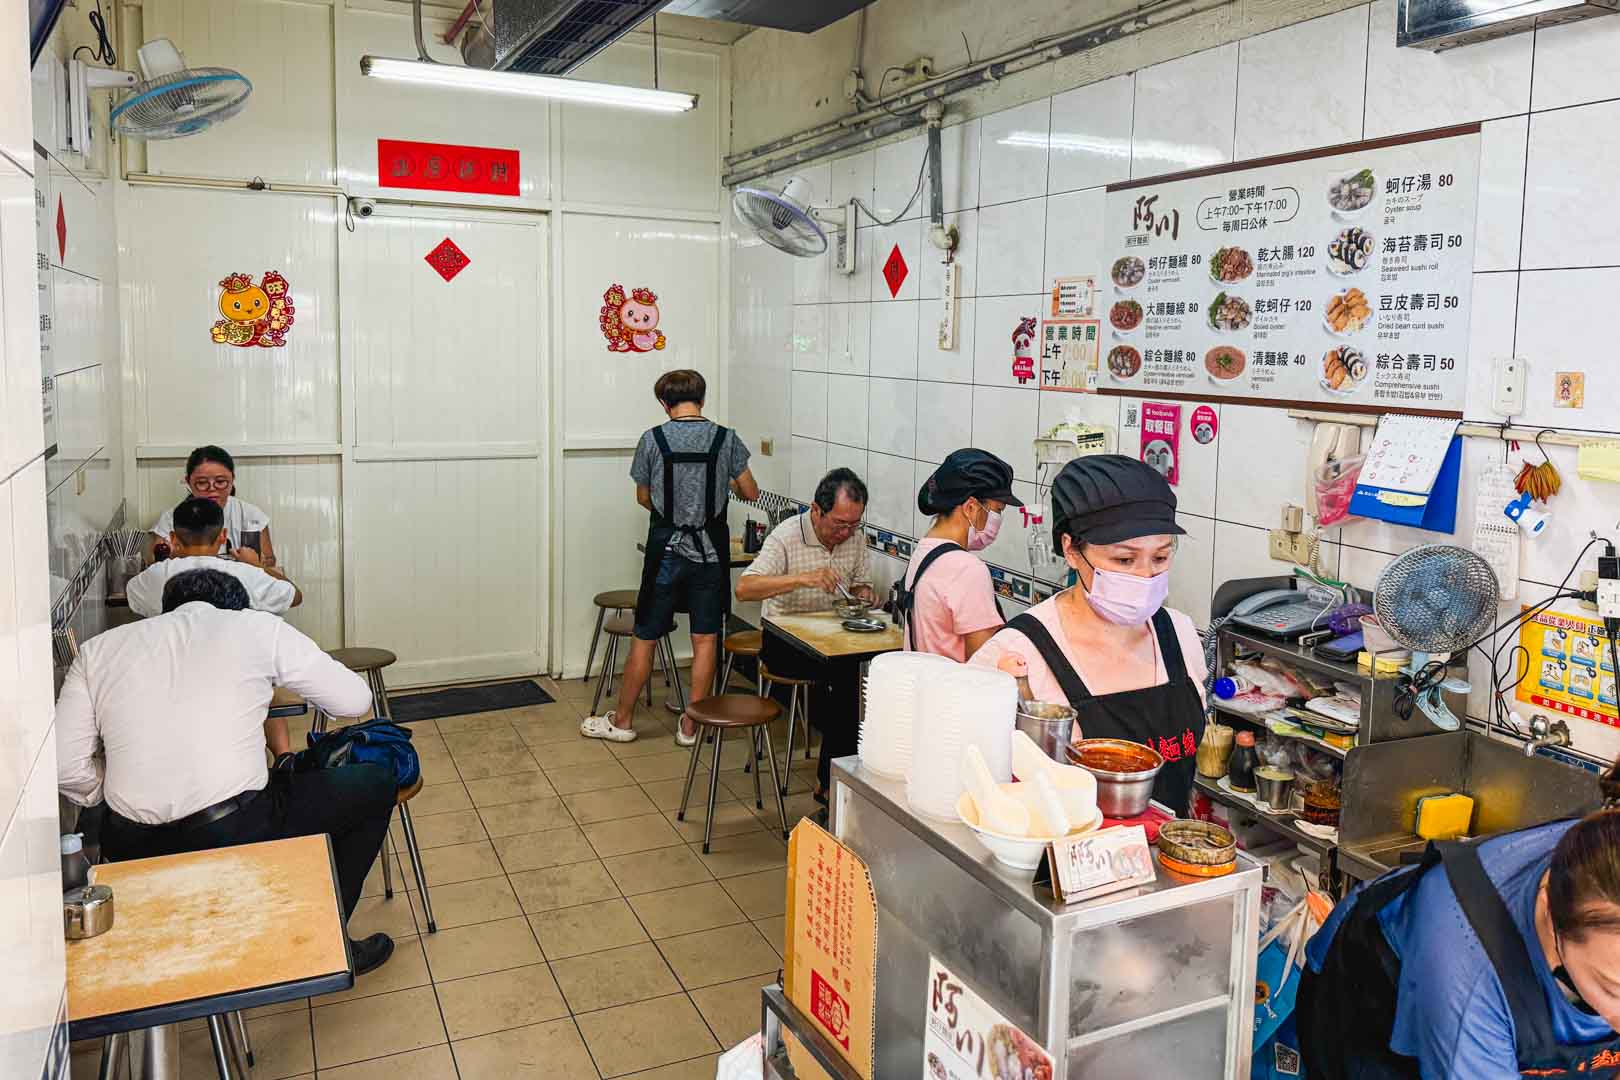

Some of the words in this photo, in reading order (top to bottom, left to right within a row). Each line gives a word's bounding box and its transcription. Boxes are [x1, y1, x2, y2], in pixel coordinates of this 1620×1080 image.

[1385, 173, 1431, 194] 蚵仔湯
[1438, 174, 1453, 187] 80
[1229, 185, 1265, 201] 營業時間
[1385, 206, 1405, 214] Oyster
[1382, 233, 1444, 253] 海苔壽司
[1447, 235, 1462, 248] 50
[1257, 245, 1294, 262] 乾大腸
[1297, 246, 1315, 258] 120
[1148, 254, 1188, 270] 蚵仔麵線
[1191, 255, 1201, 265] 80
[1381, 264, 1409, 273] Seaweed
[1410, 264, 1428, 272] sushi
[1146, 302, 1185, 316] 大腸麵線
[1188, 303, 1199, 313] 80
[1255, 298, 1292, 313] 乾蚵仔
[1294, 300, 1312, 311] 120
[1378, 293, 1440, 311] 豆皮壽司
[1443, 296, 1458, 308] 50
[1045, 325, 1096, 341] 營業時間
[1143, 349, 1183, 363] 綜合麵線
[1186, 351, 1196, 362] 80
[1252, 351, 1288, 366] 清麵線
[1293, 354, 1306, 365] 40
[1375, 353, 1436, 371] 綜合壽司
[1440, 357, 1455, 370] 50
[1374, 381, 1421, 389] Comprehensive
[1422, 382, 1440, 390] sushi
[1145, 419, 1174, 435] 取餐區
[1146, 728, 1197, 763] 麵線
